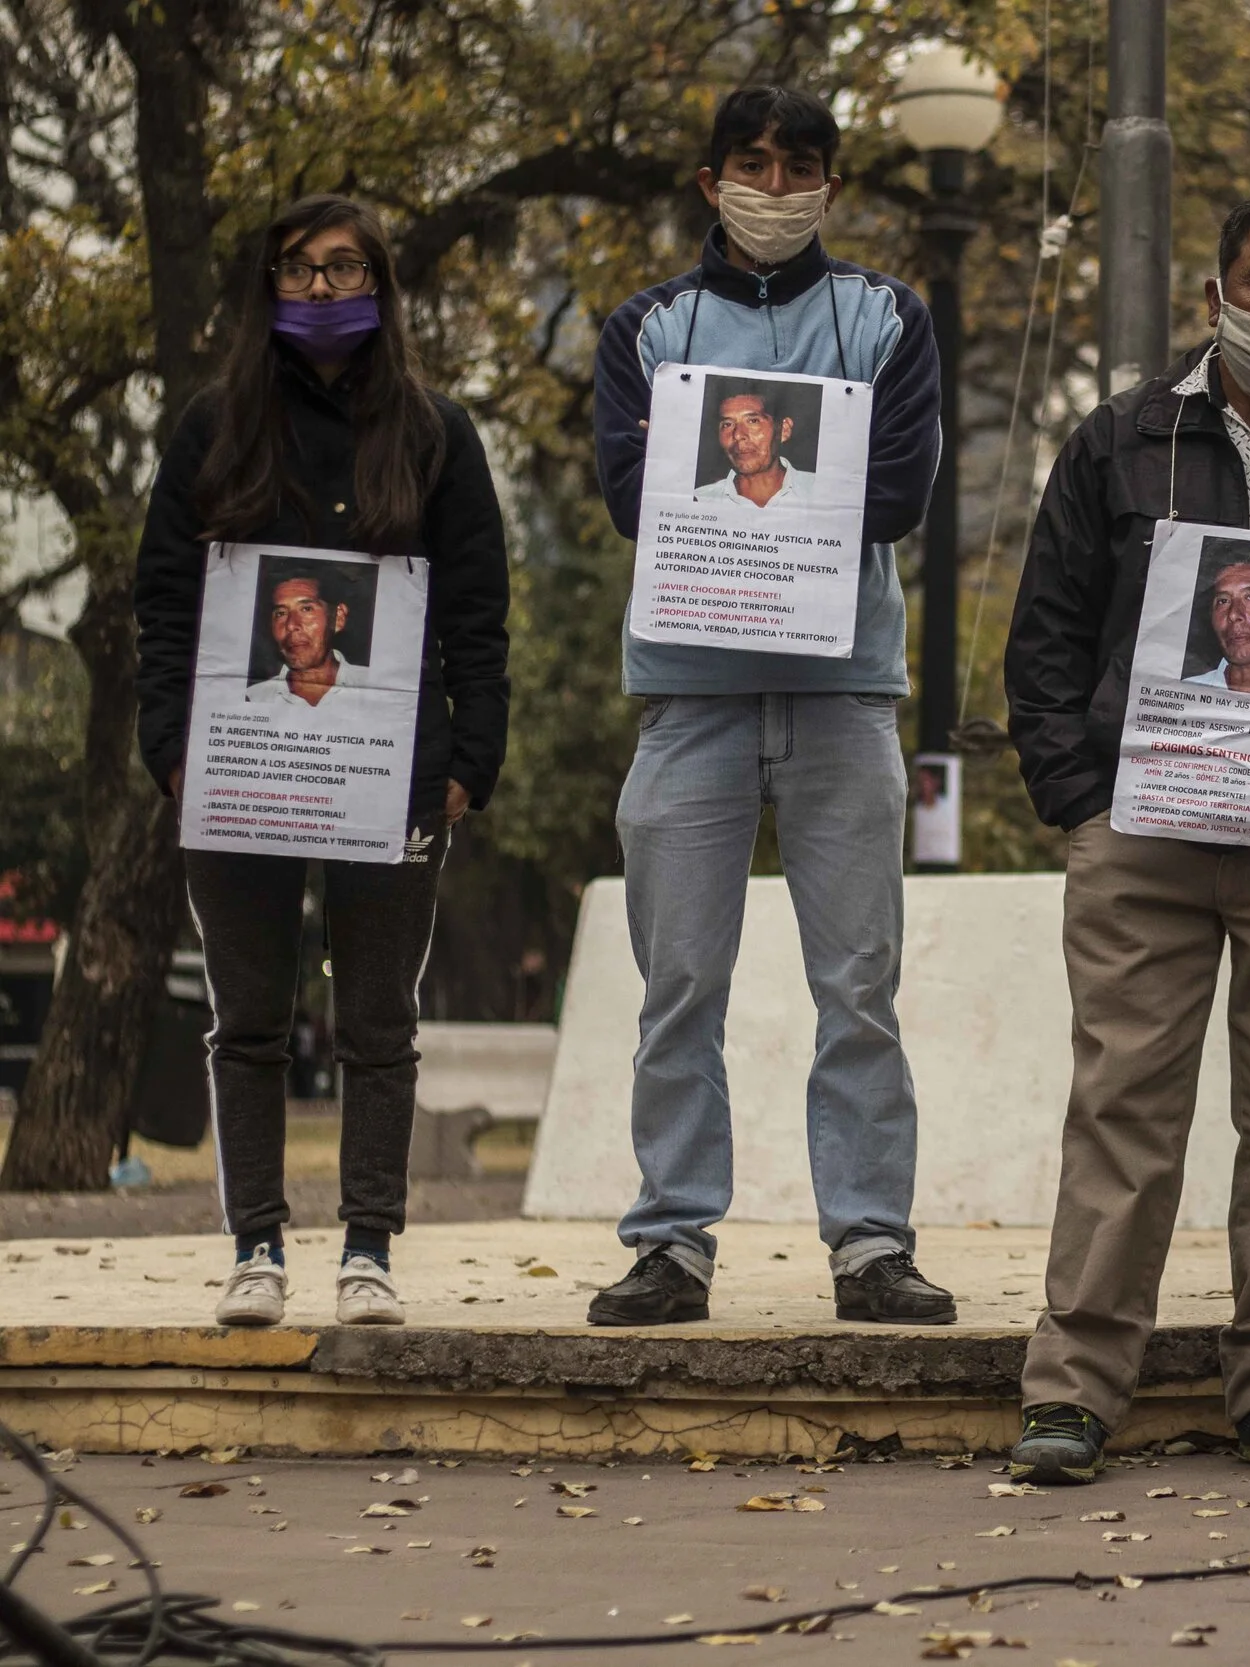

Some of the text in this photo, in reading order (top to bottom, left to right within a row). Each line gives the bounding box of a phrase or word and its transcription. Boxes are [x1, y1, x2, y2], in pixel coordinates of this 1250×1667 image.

[657, 534, 779, 553] LOS PUEBLOS ORIGINARIOS
[658, 523, 842, 547] EN ARGENTINA NO HAY JUSTICIA PARA
[655, 550, 839, 574] LIBERARON A LOS ASESINOS DE NUESTRA
[654, 562, 794, 582] AUTORIDAD JAVIER CHOCOBAR
[658, 582, 781, 600] ¡JAVIER CHOCOBAR PRESENTE!
[657, 594, 794, 613] ¡BASTA DE DESPOJO TERRITORIAL!
[655, 607, 783, 625] ¡PROPIEDAD COMUNITARIA YA!
[654, 620, 702, 632] ¡MEMORIA,
[703, 624, 740, 635] VERDAD,
[741, 627, 777, 637] JUSTICIA
[785, 631, 837, 643] TERRITORIO!
[1138, 697, 1185, 711] ORIGINARIOS
[1140, 686, 1151, 695] EN
[1154, 688, 1196, 702] ARGENTINA
[1199, 694, 1212, 704] NO
[1215, 697, 1231, 706] HAY
[1134, 723, 1161, 734] JAVIER
[1136, 712, 1177, 726] LIBERARON
[1181, 719, 1187, 727] A
[1190, 720, 1205, 729] LOS
[1208, 722, 1244, 734] ASESINOS
[209, 725, 394, 747] EN ARGENTINA NO HAY JUSTICIA PARA
[208, 738, 331, 755] LOS PUEBLOS ORIGINARIOS
[1150, 740, 1203, 757] ¡EXIGIMOS
[206, 754, 391, 776] LIBERARON A LOS ASESINOS DE NUESTRA
[1214, 765, 1227, 773] LAS
[204, 767, 346, 785] AUTORIDAD JAVIER CHOCOBAR
[208, 788, 332, 804] ¡JAVIER CHOCOBAR PRESENTE!
[1138, 792, 1164, 803] ¡BASTA
[1165, 795, 1176, 803] DE
[1176, 797, 1209, 808] DESPOJO
[1140, 781, 1246, 800] ¡JAVIER CHOCOBAR PRESENTE!
[207, 801, 238, 811] ¡BASTA
[251, 804, 289, 814] DESPOJO
[290, 807, 346, 819] TERRITORIAL!
[1136, 804, 1246, 823] ¡PROPIEDAD COMUNITARIA YA!
[206, 815, 334, 831] ¡PROPIEDAD COMUNITARIA YA!
[1135, 815, 1176, 828] ¡MEMORIA,
[1177, 820, 1209, 831] VERDAD,
[1209, 824, 1240, 834] JUSTICIA
[205, 828, 253, 839] ¡MEMORIA,
[254, 831, 291, 842] VERDAD,
[292, 834, 328, 844] JUSTICIA
[335, 837, 388, 849] TERRITORIO!
[402, 852, 428, 862] didas
